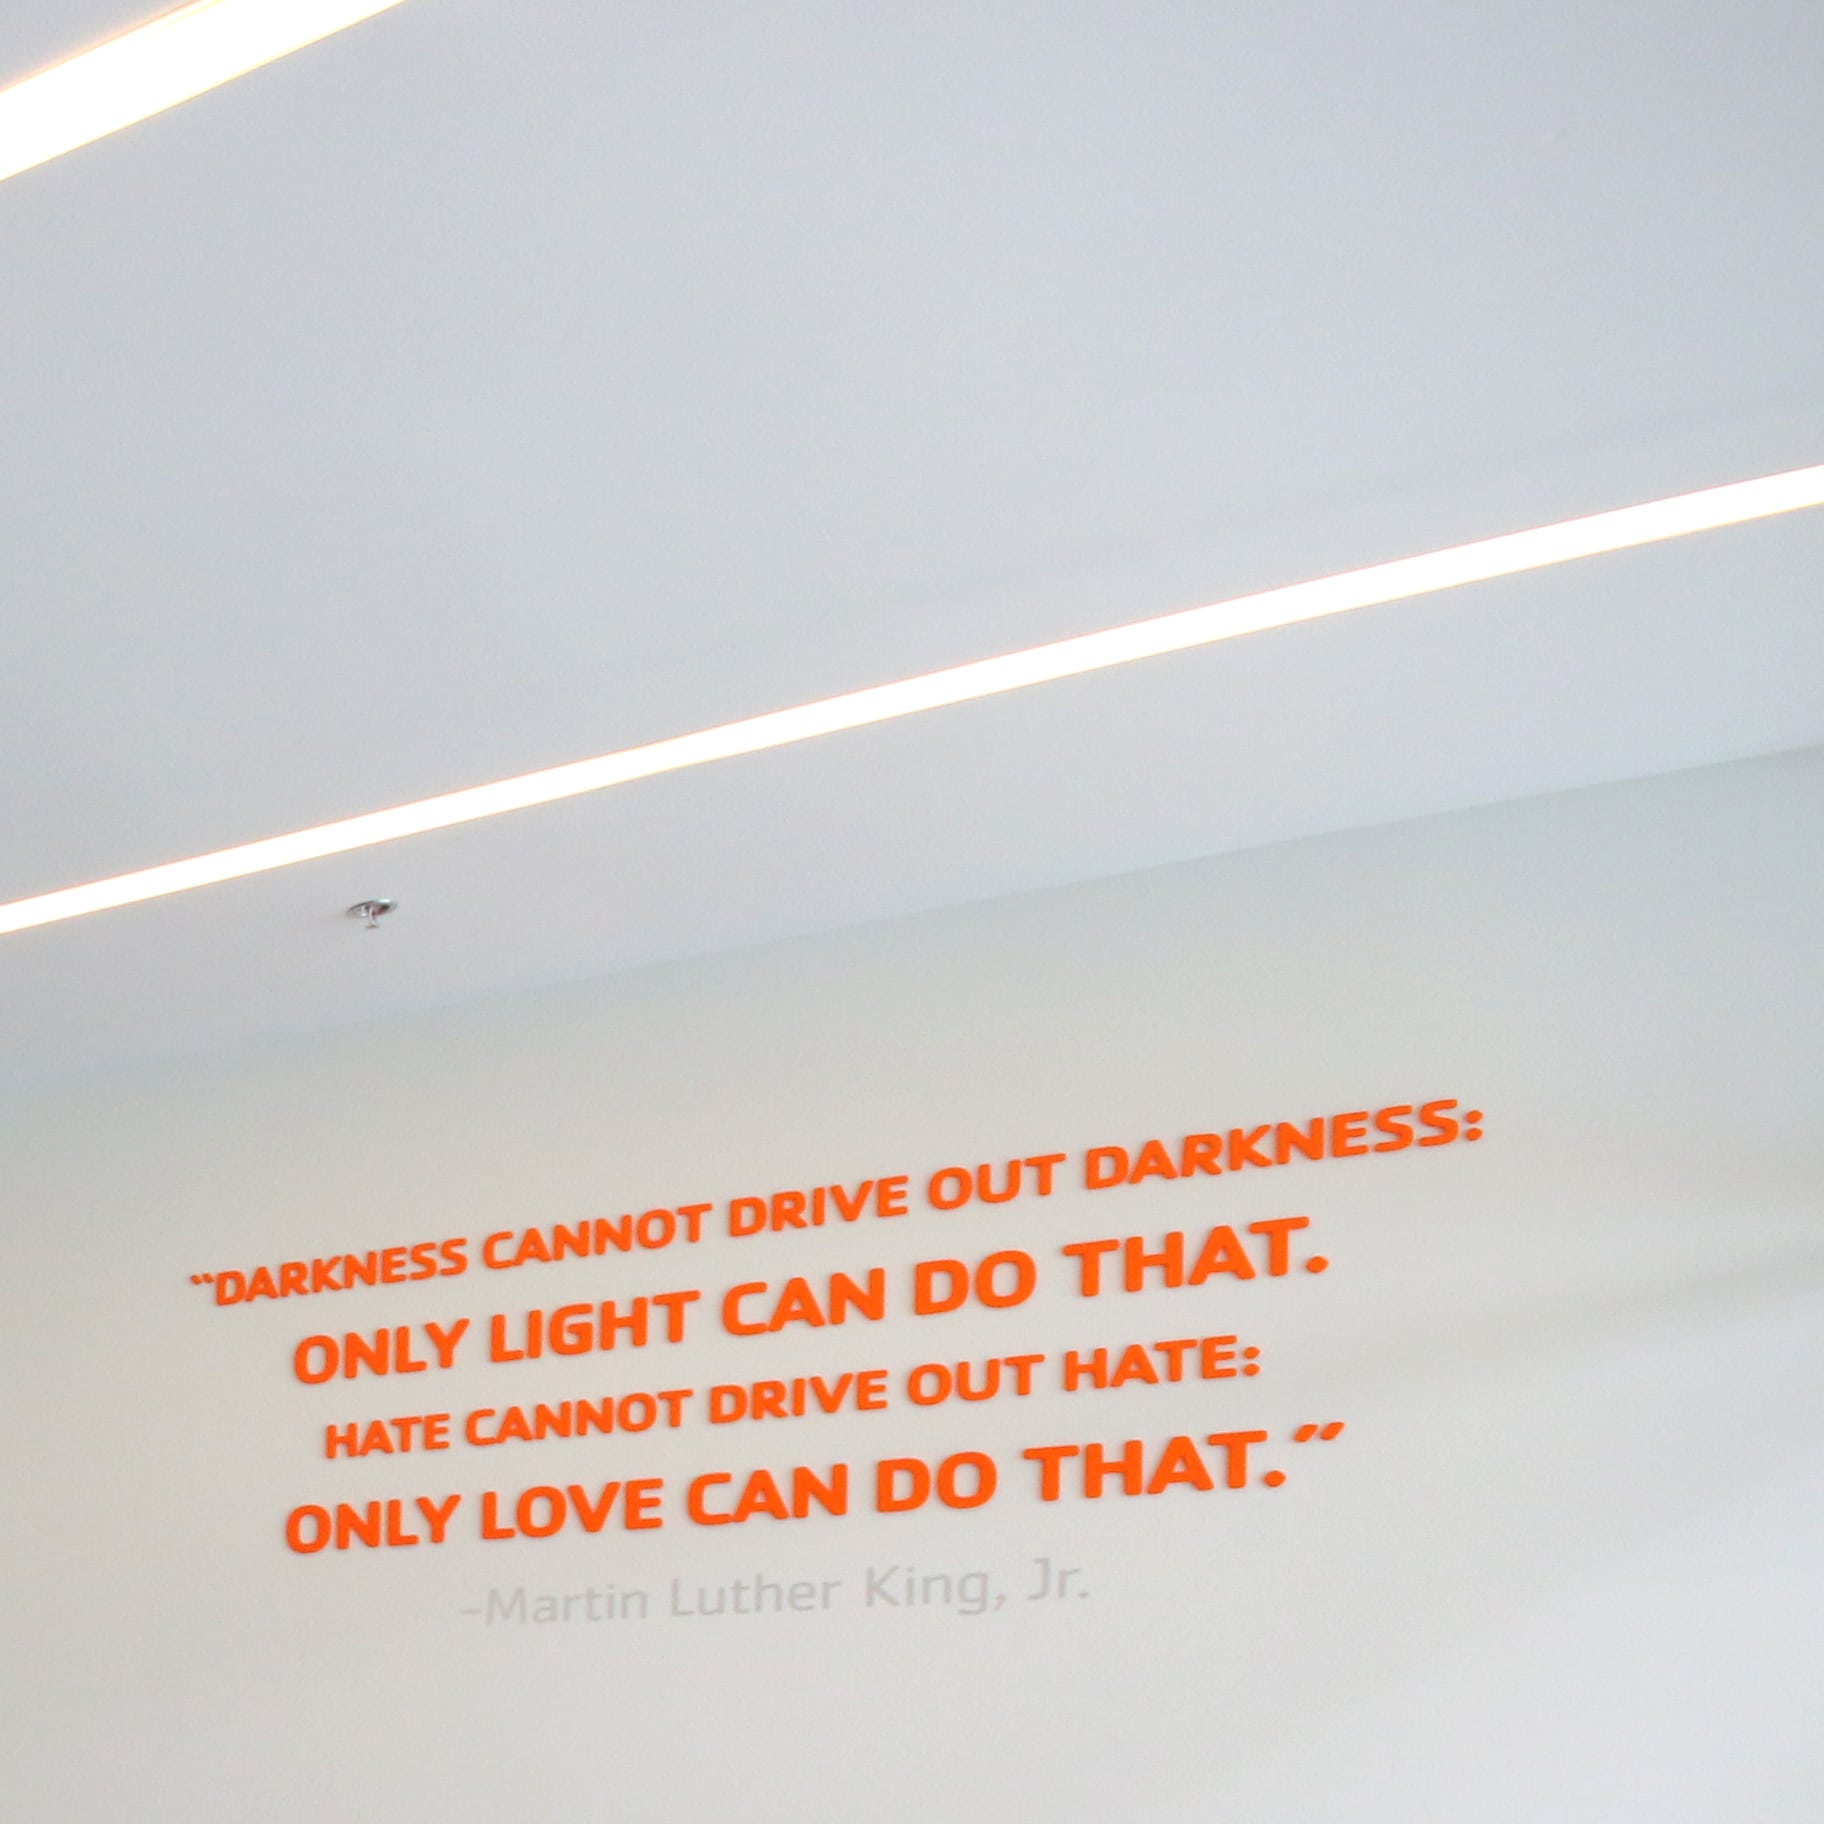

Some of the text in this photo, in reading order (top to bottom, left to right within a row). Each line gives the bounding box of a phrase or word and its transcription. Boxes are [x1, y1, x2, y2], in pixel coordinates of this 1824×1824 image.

[481, 1202, 714, 1270] CANNOT
[728, 1175, 911, 1238] DRIVE
[927, 1152, 1068, 1211] OUT
[1084, 1098, 1484, 1190] DARKNESS:
[293, 1216, 1329, 1385] ONLY LIGHT CAN DO THAT.
[325, 1334, 1261, 1460] HATE CANNOT DRIVE OUT HATE:
[285, 1493, 463, 1554] ONLY
[481, 1477, 665, 1540] LOVE
[686, 1463, 849, 1526] CAN
[875, 1451, 999, 1513] DO
[669, 1575, 843, 1617] Luther
[866, 1564, 1008, 1614] King,
[1027, 1557, 1091, 1601] Jr.
